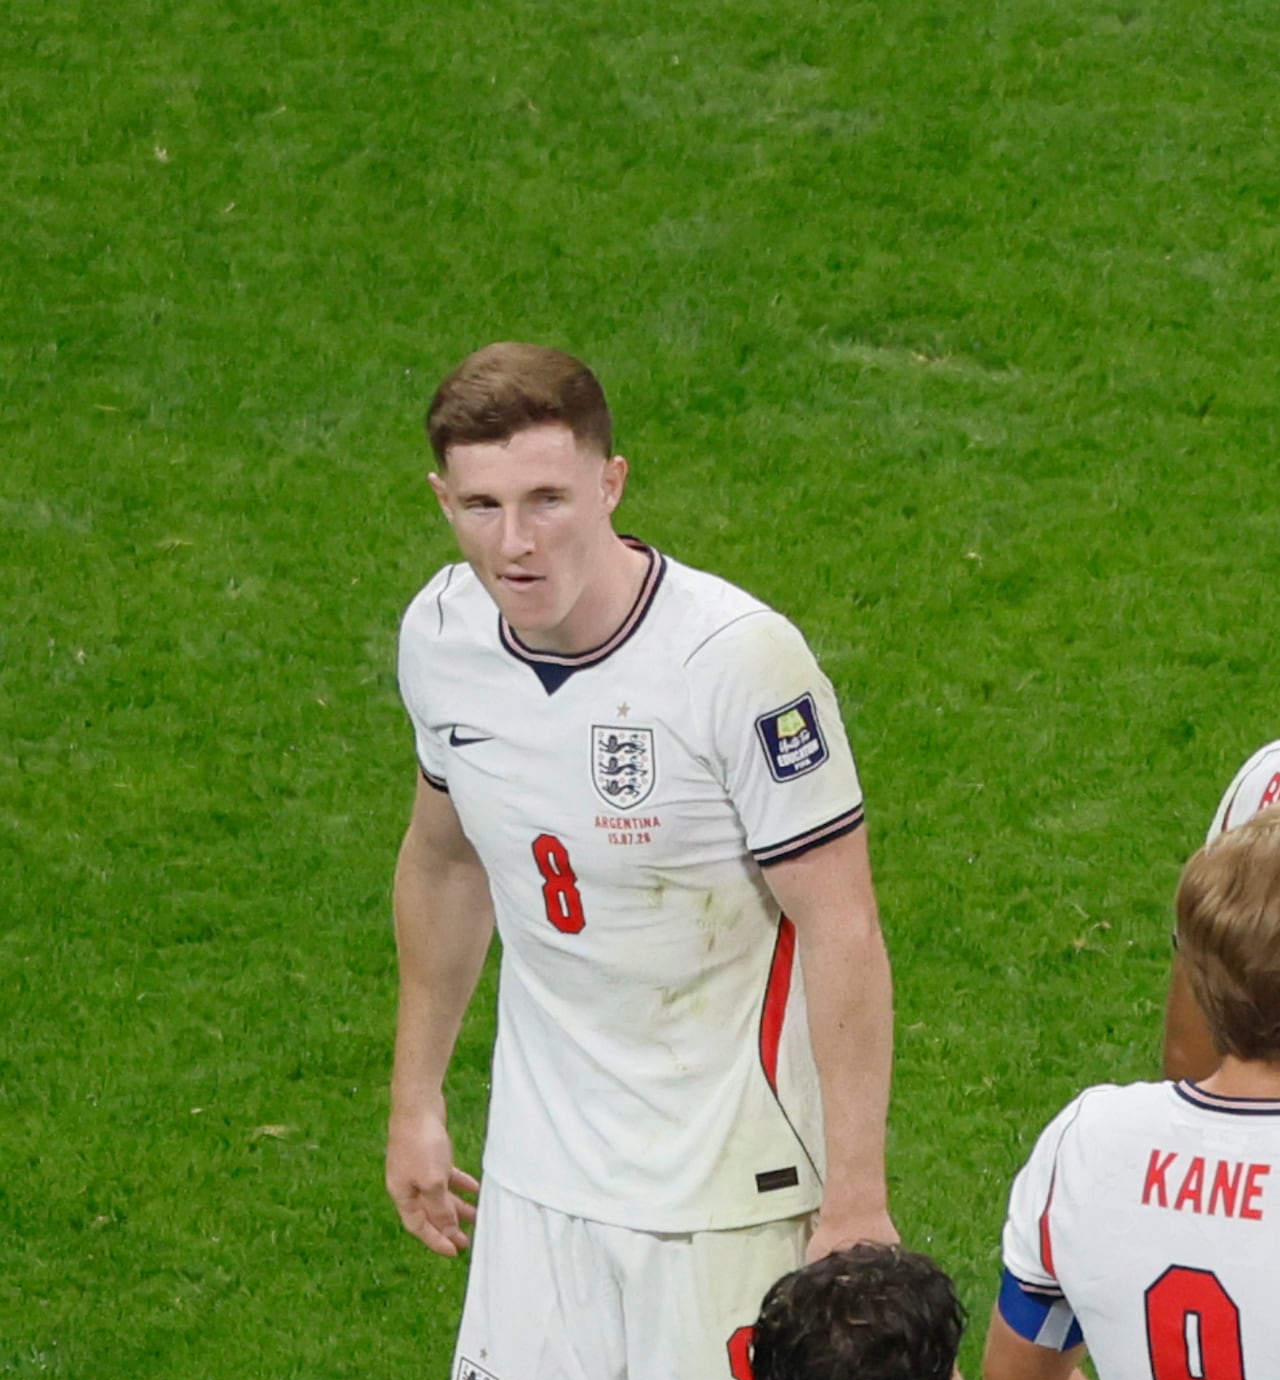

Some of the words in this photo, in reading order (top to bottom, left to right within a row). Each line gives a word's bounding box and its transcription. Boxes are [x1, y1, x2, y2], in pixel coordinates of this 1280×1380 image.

[595, 815, 661, 830] ARGENTINA
[608, 832, 652, 845] 15.07.26
[531, 833, 586, 935] 8
[1141, 1149, 1271, 1220] KANE
